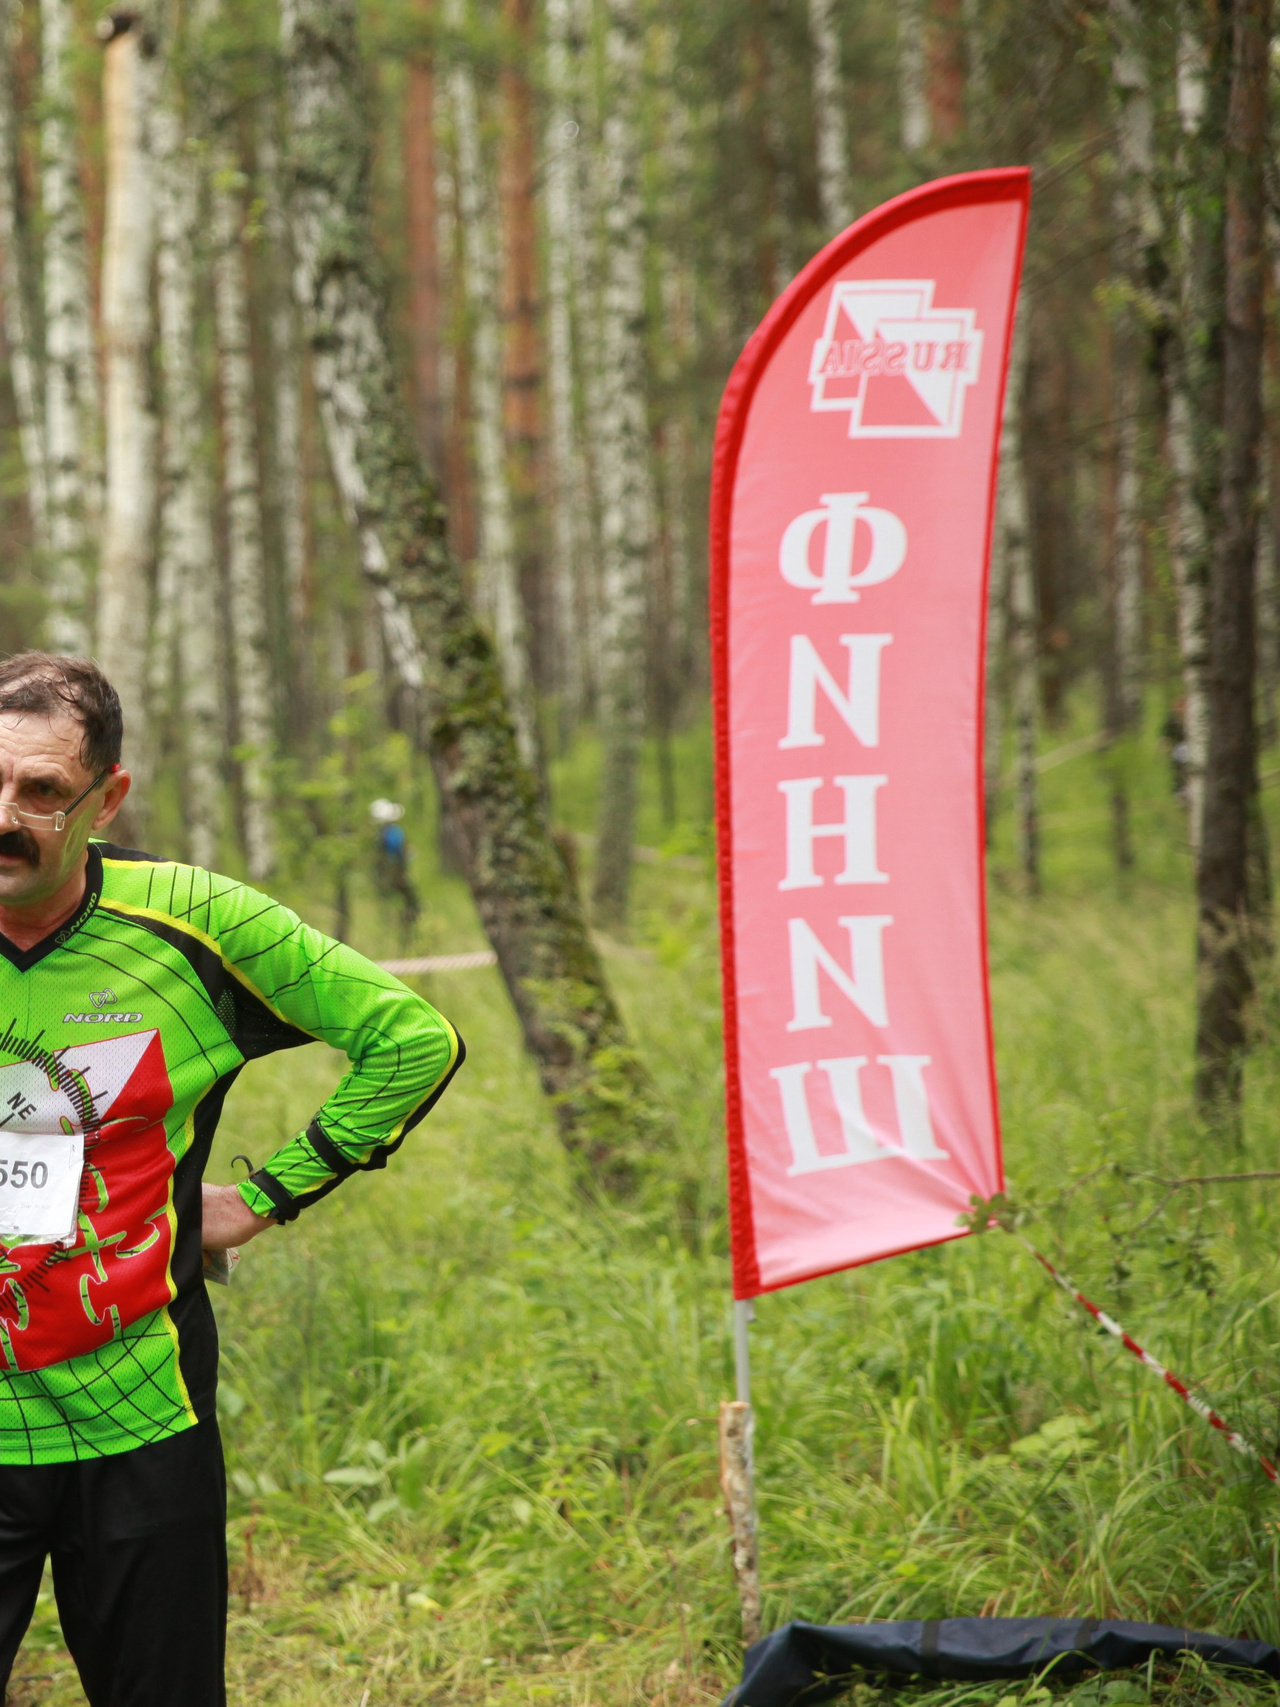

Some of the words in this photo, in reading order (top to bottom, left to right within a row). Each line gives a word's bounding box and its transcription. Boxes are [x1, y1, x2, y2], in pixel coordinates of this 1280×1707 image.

[70, 892, 98, 933] NORD
[62, 1012, 145, 1025] NORD
[6, 1091, 37, 1122] NE
